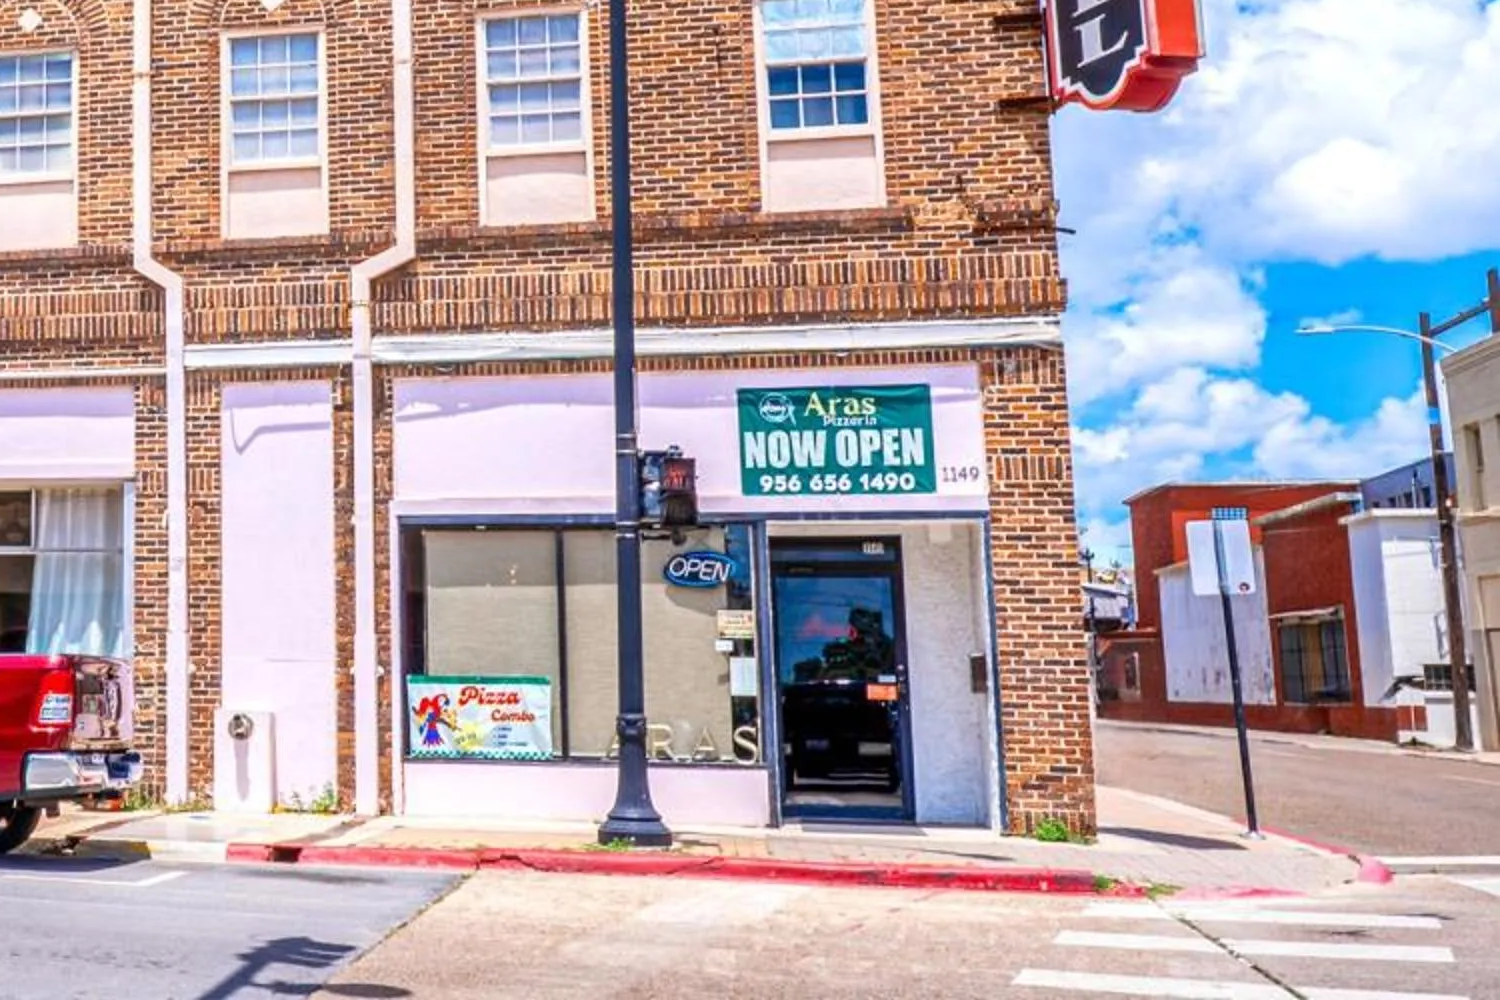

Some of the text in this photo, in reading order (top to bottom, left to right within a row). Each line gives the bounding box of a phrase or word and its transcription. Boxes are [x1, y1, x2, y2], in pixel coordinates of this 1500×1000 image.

[803, 391, 877, 417] Aras
[823, 415, 877, 427] Pizzeria
[744, 427, 925, 469] NOW OPEN
[759, 471, 916, 493] 956 656 1490
[942, 466, 980, 483] 1149
[669, 557, 731, 582] OPEN
[458, 686, 520, 706] Pizza
[491, 709, 536, 722] Combo
